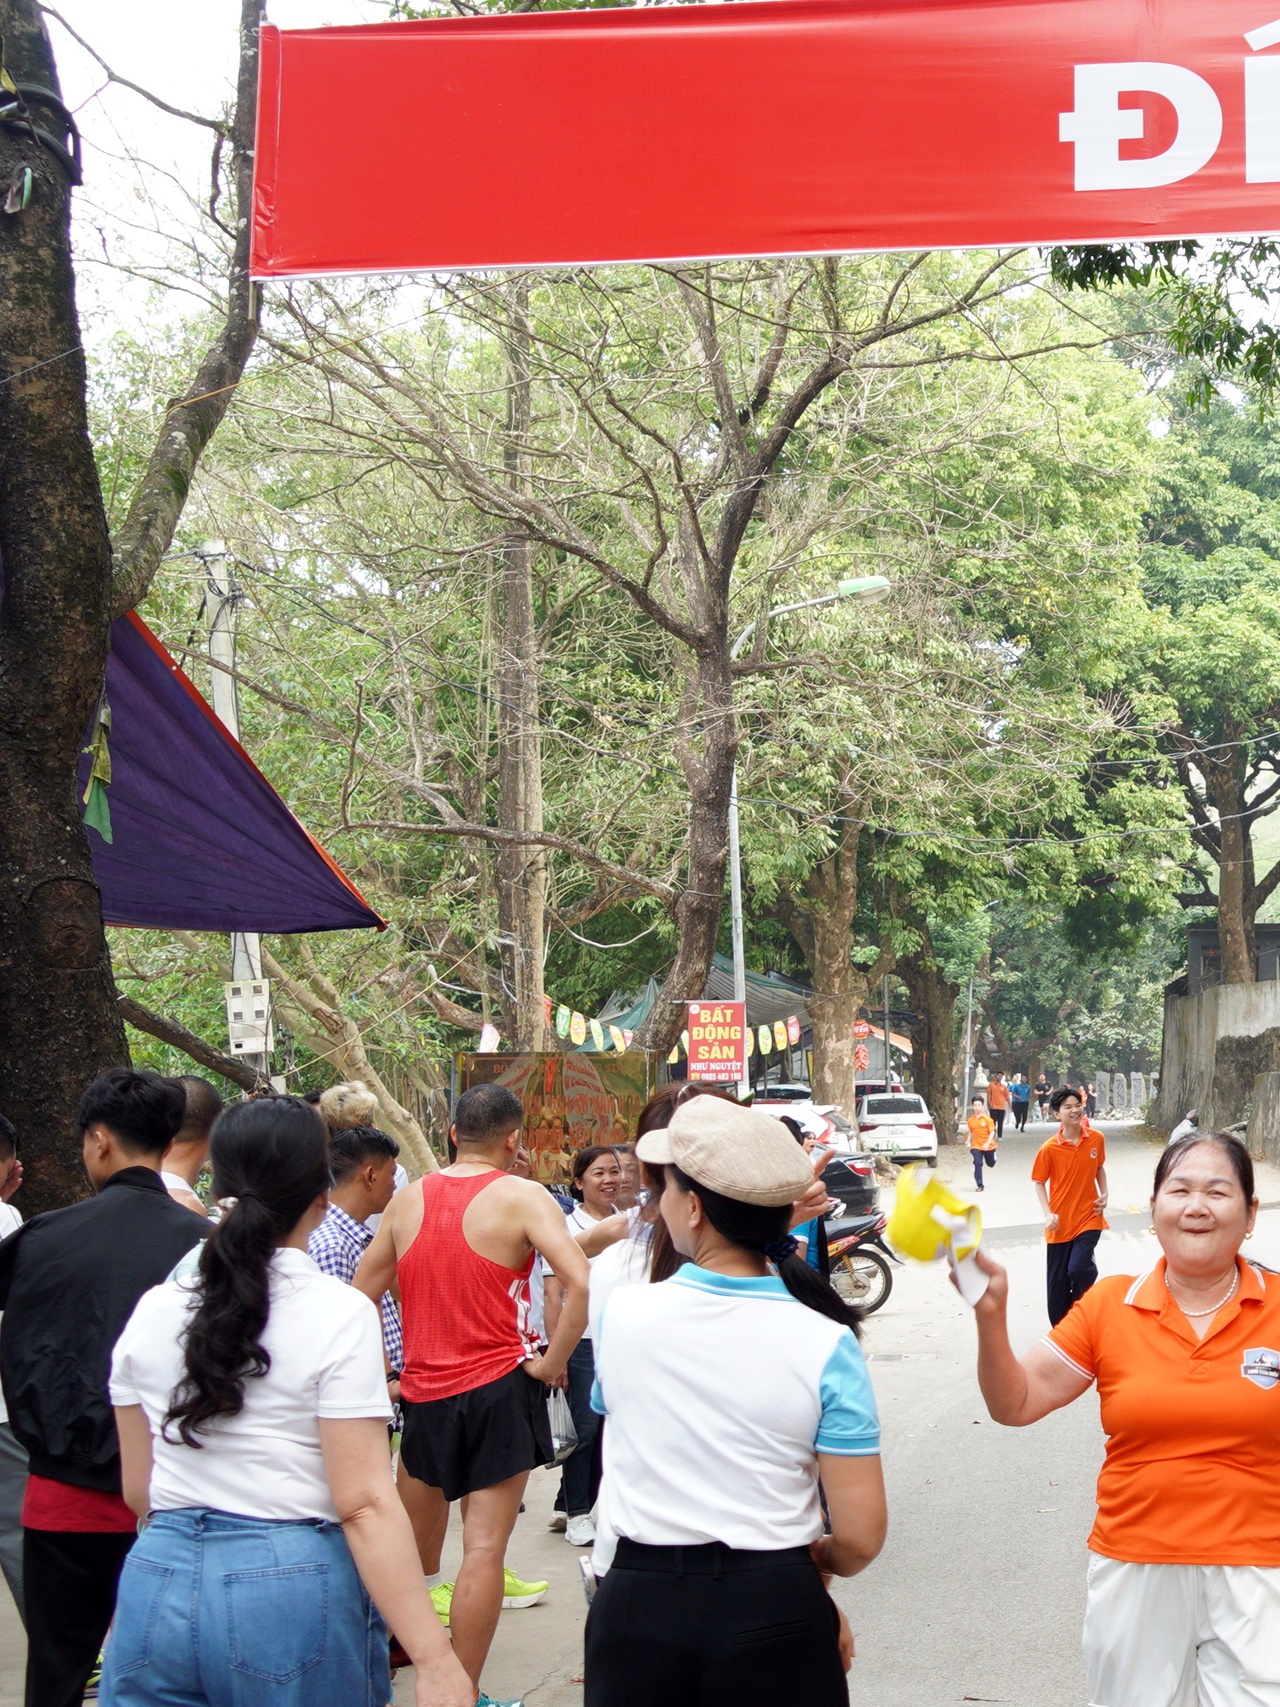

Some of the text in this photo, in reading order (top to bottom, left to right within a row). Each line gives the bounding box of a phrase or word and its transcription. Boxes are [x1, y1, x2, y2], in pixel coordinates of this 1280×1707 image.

[700, 1005, 734, 1023] BẤT
[692, 1024, 741, 1043] ĐỘNG
[698, 1042, 735, 1059] SẢN
[690, 1060, 742, 1072] NHƯ NGUYỆT
